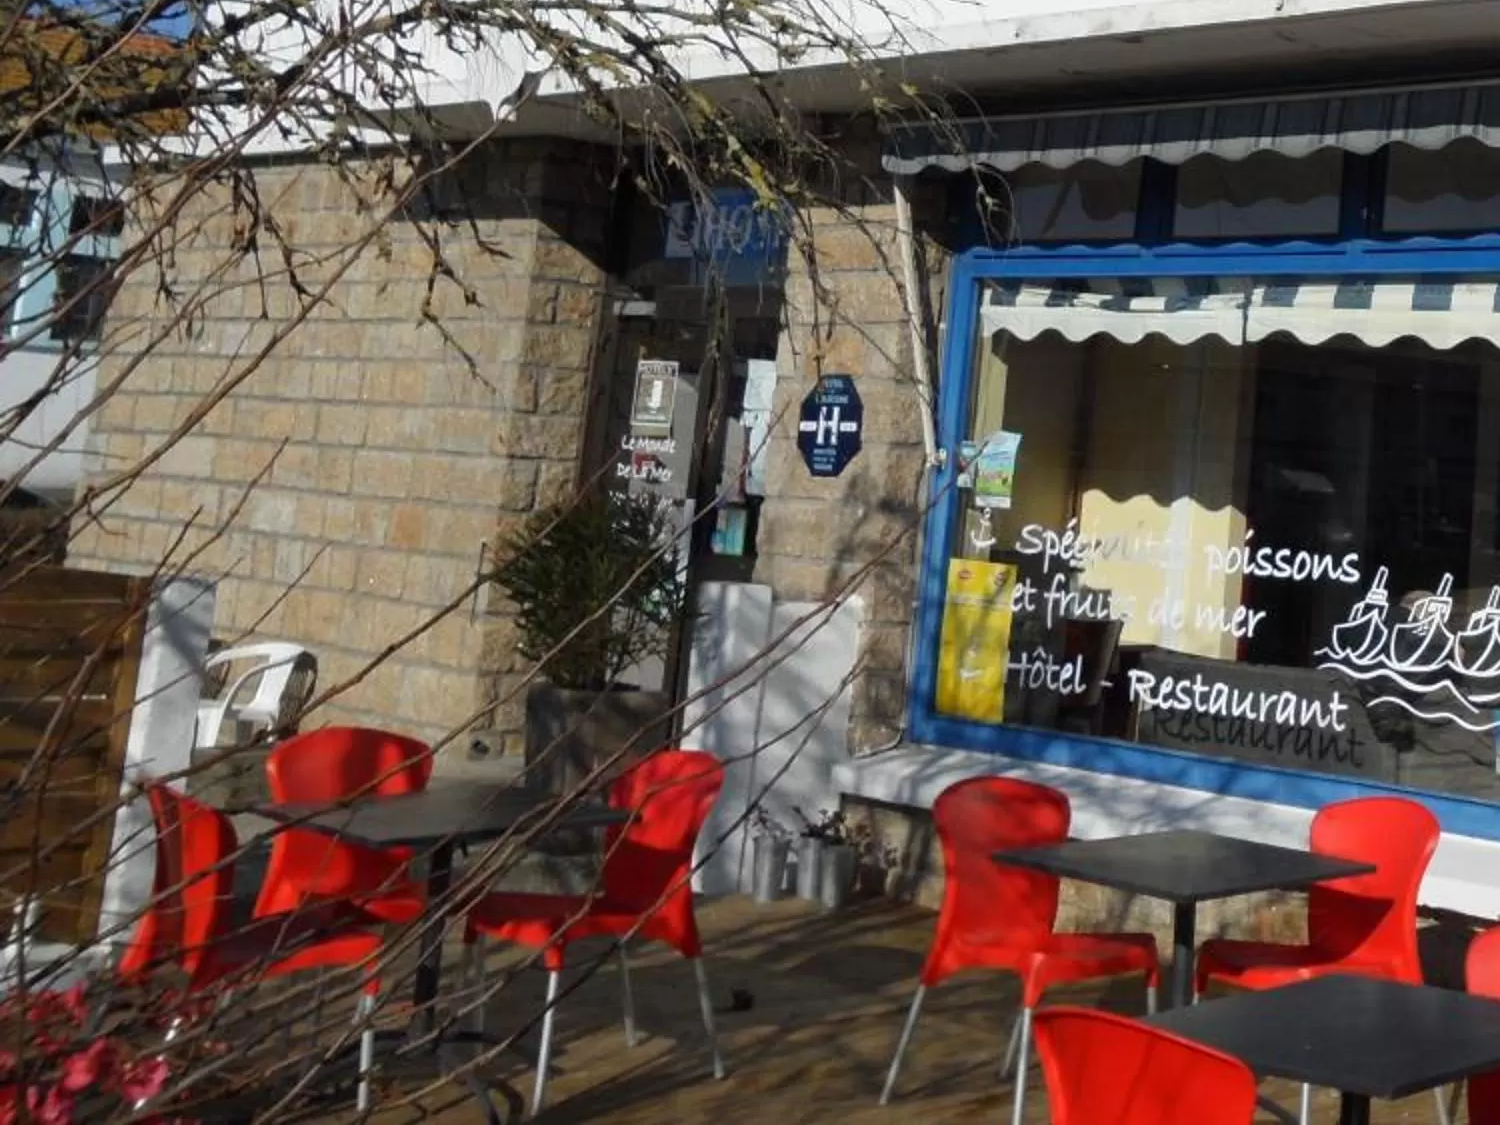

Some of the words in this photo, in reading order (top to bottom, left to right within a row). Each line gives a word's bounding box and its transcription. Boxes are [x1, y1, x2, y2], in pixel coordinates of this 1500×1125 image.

[1204, 528, 1362, 584] poissons
[1010, 578, 1038, 613] et
[1196, 605, 1267, 640] mer
[1127, 669, 1350, 733] Restaurant
